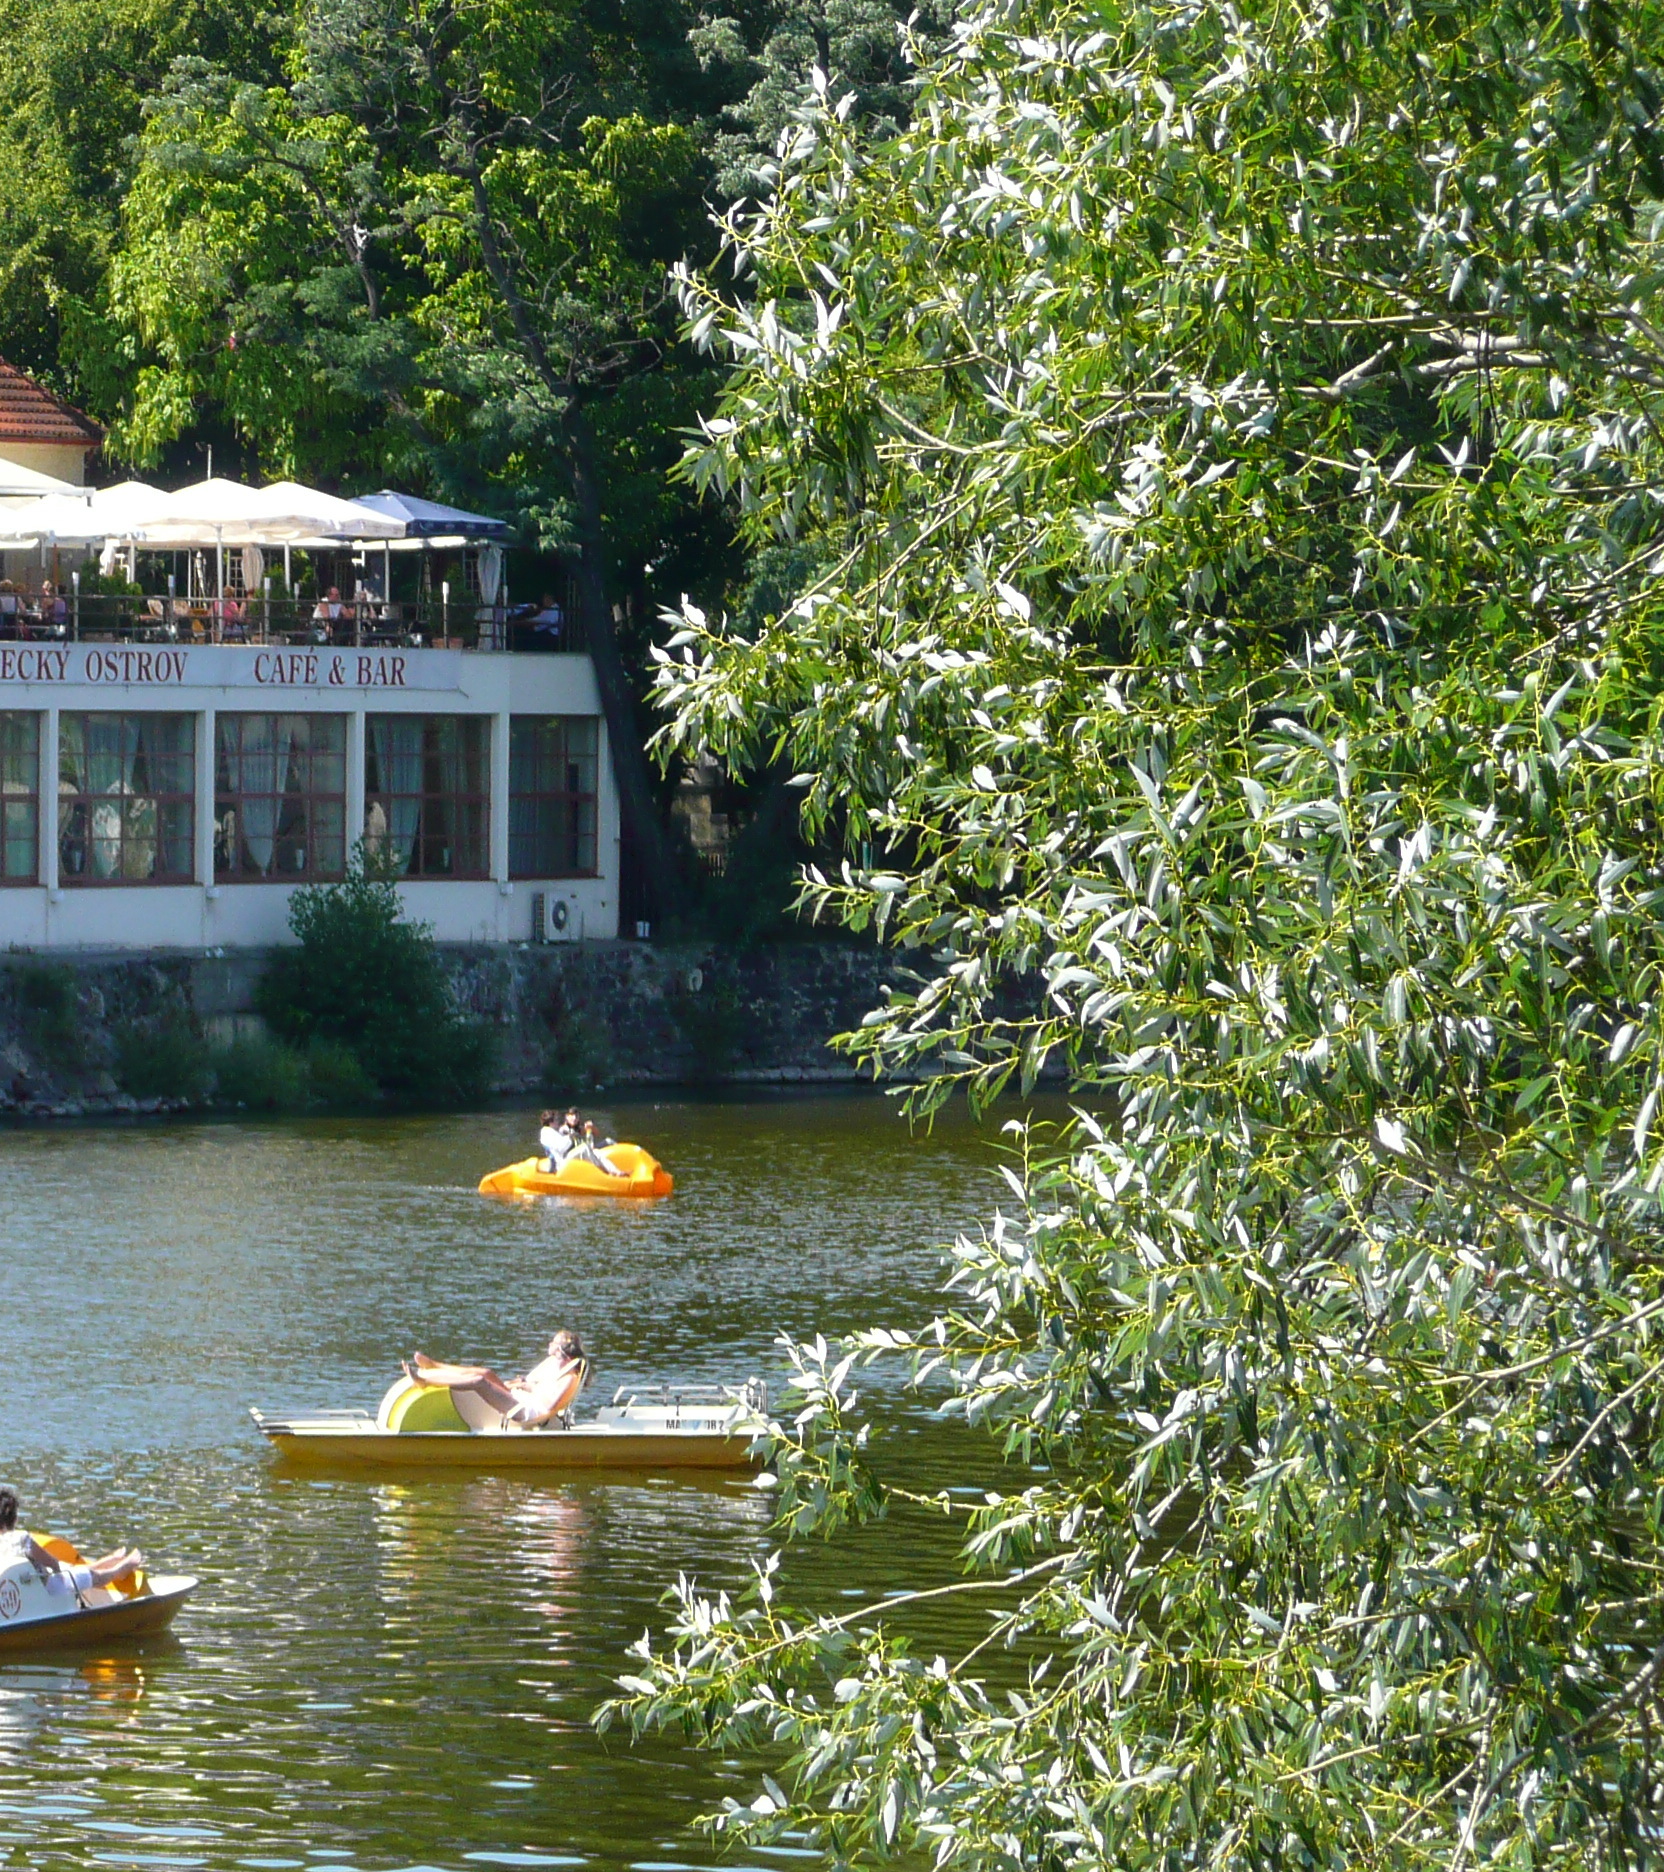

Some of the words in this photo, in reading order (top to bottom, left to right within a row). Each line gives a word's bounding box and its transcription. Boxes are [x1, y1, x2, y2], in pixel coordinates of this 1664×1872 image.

[86, 650, 189, 682] OSTROV
[254, 646, 318, 684] CAFÉ
[328, 655, 346, 685] &
[357, 656, 406, 686] BAR
